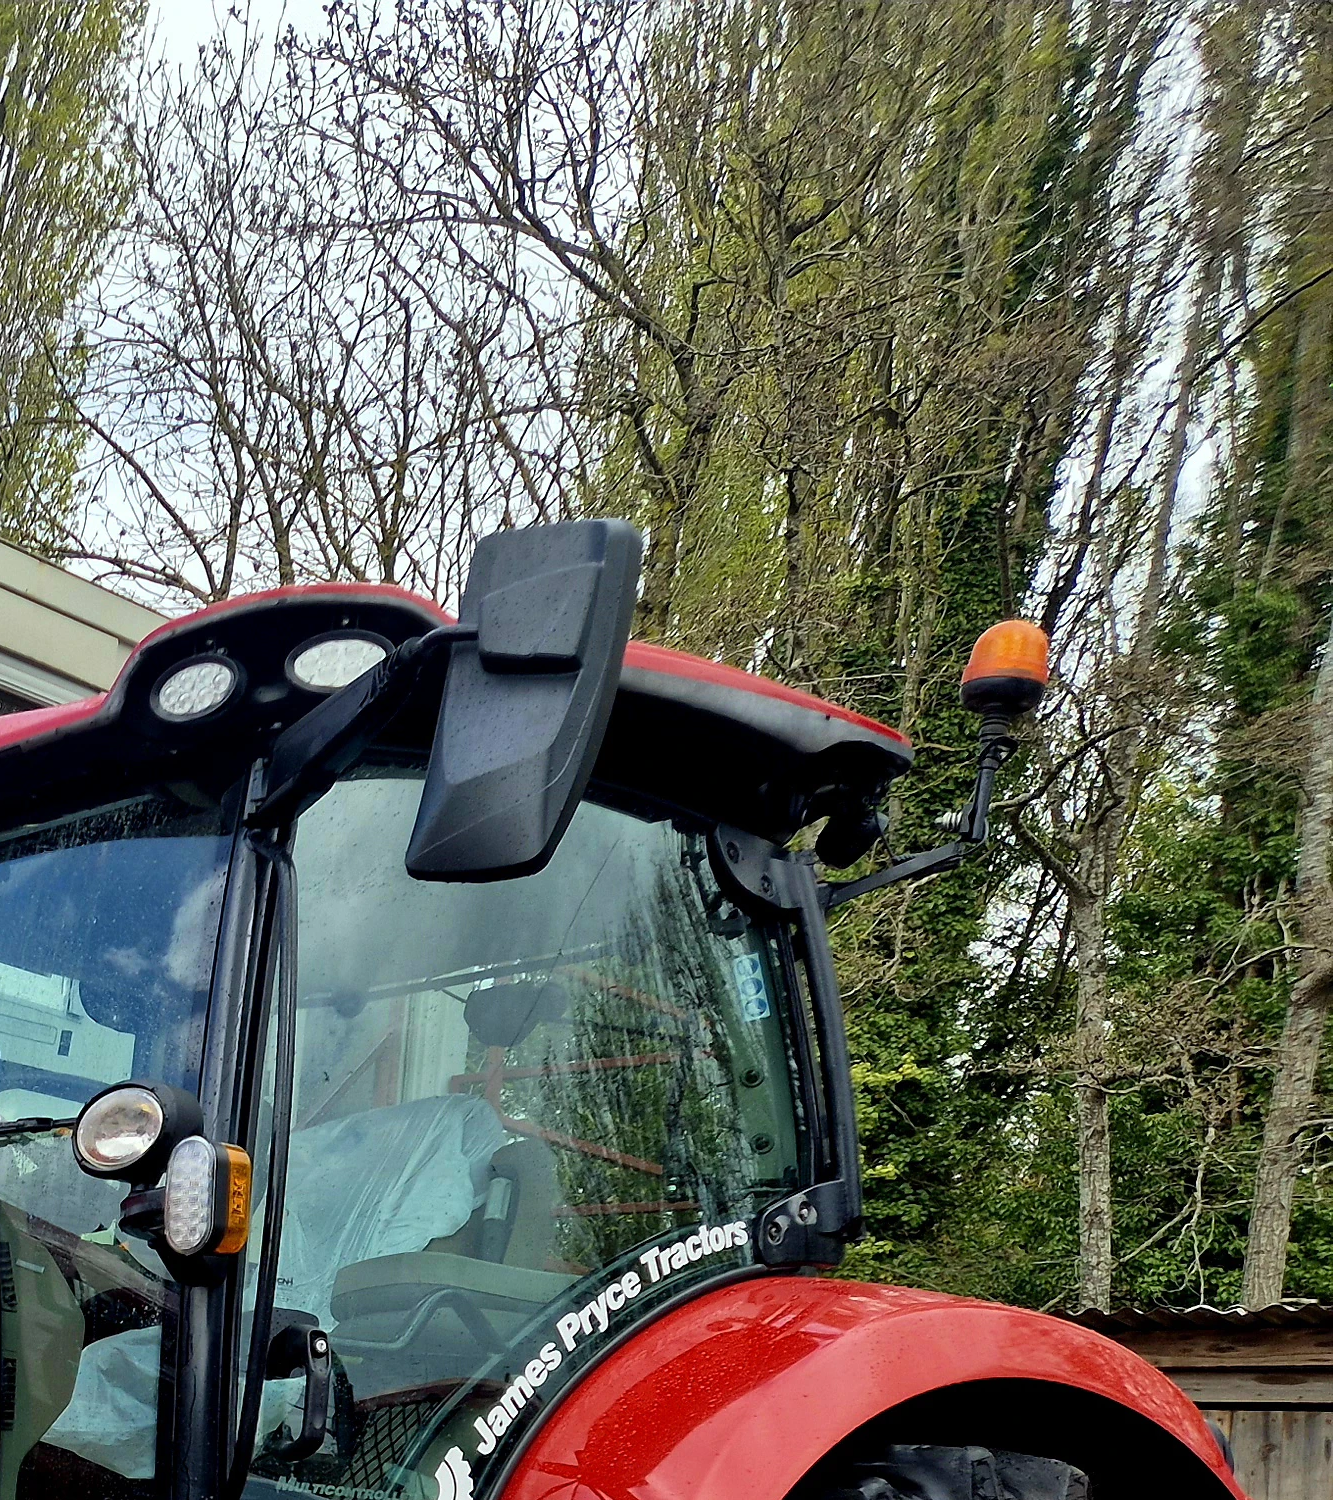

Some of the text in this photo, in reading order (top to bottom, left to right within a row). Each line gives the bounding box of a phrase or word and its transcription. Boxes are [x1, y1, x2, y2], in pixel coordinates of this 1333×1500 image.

[473, 1220, 749, 1455] James Pryce Tractors
